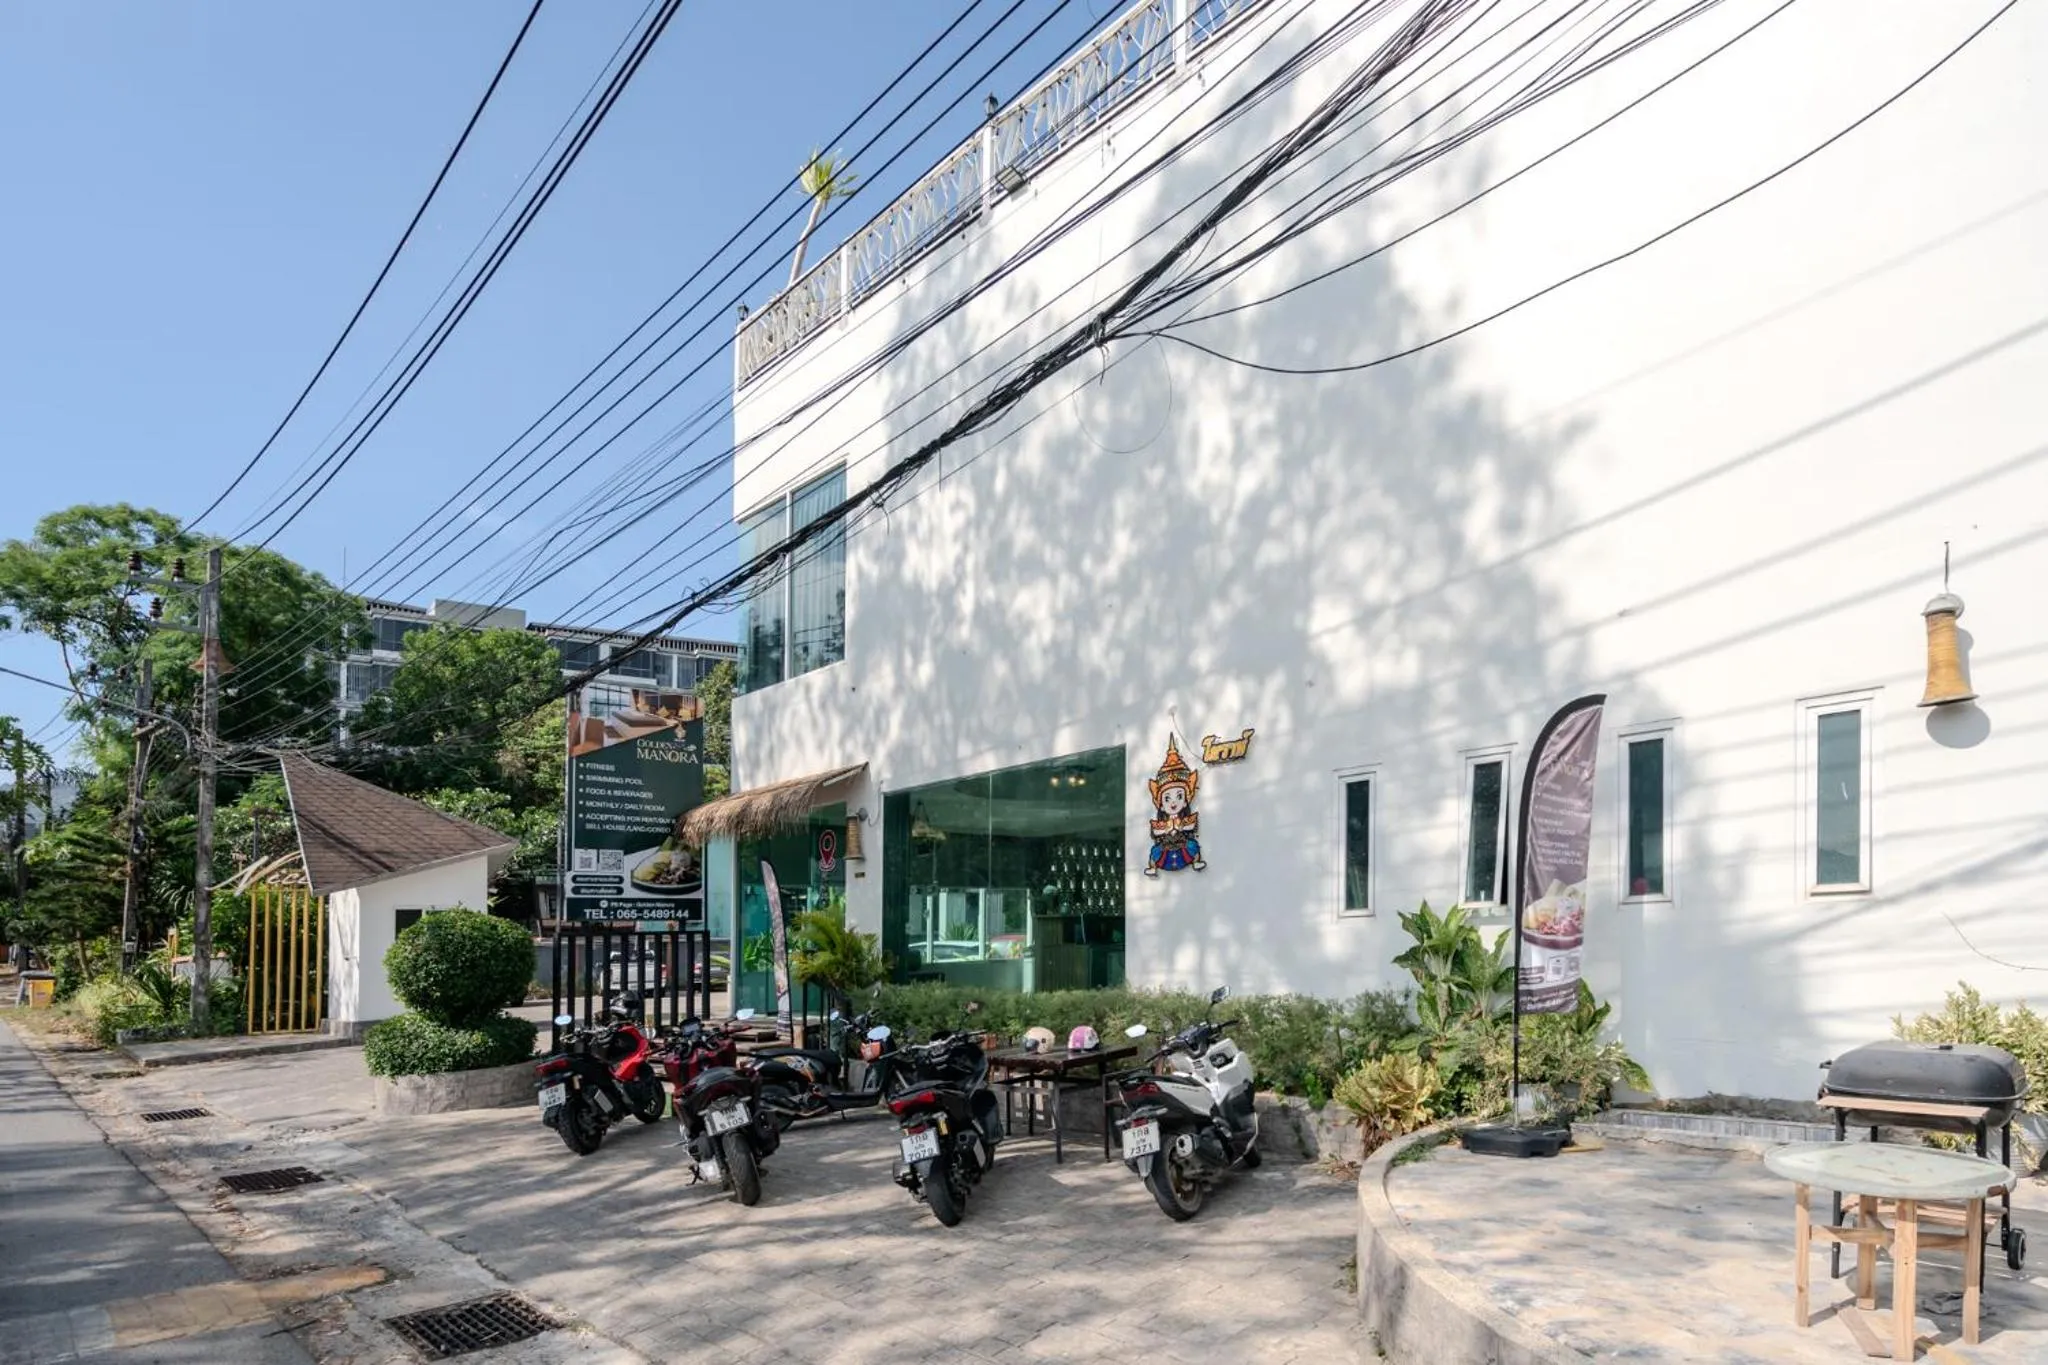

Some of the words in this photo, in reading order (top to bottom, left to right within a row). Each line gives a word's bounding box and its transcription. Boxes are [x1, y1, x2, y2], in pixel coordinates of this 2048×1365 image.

[636, 738, 673, 750] GOLDEN
[636, 748, 699, 764] MANORA
[585, 762, 616, 772] FITNESS
[585, 774, 624, 785] SWIMMING
[585, 787, 606, 795] FOOD
[585, 800, 620, 809] MONTHLY
[585, 813, 626, 822] ACCEPTING
[584, 908, 608, 919] TEL
[616, 909, 689, 919] 065-5489144
